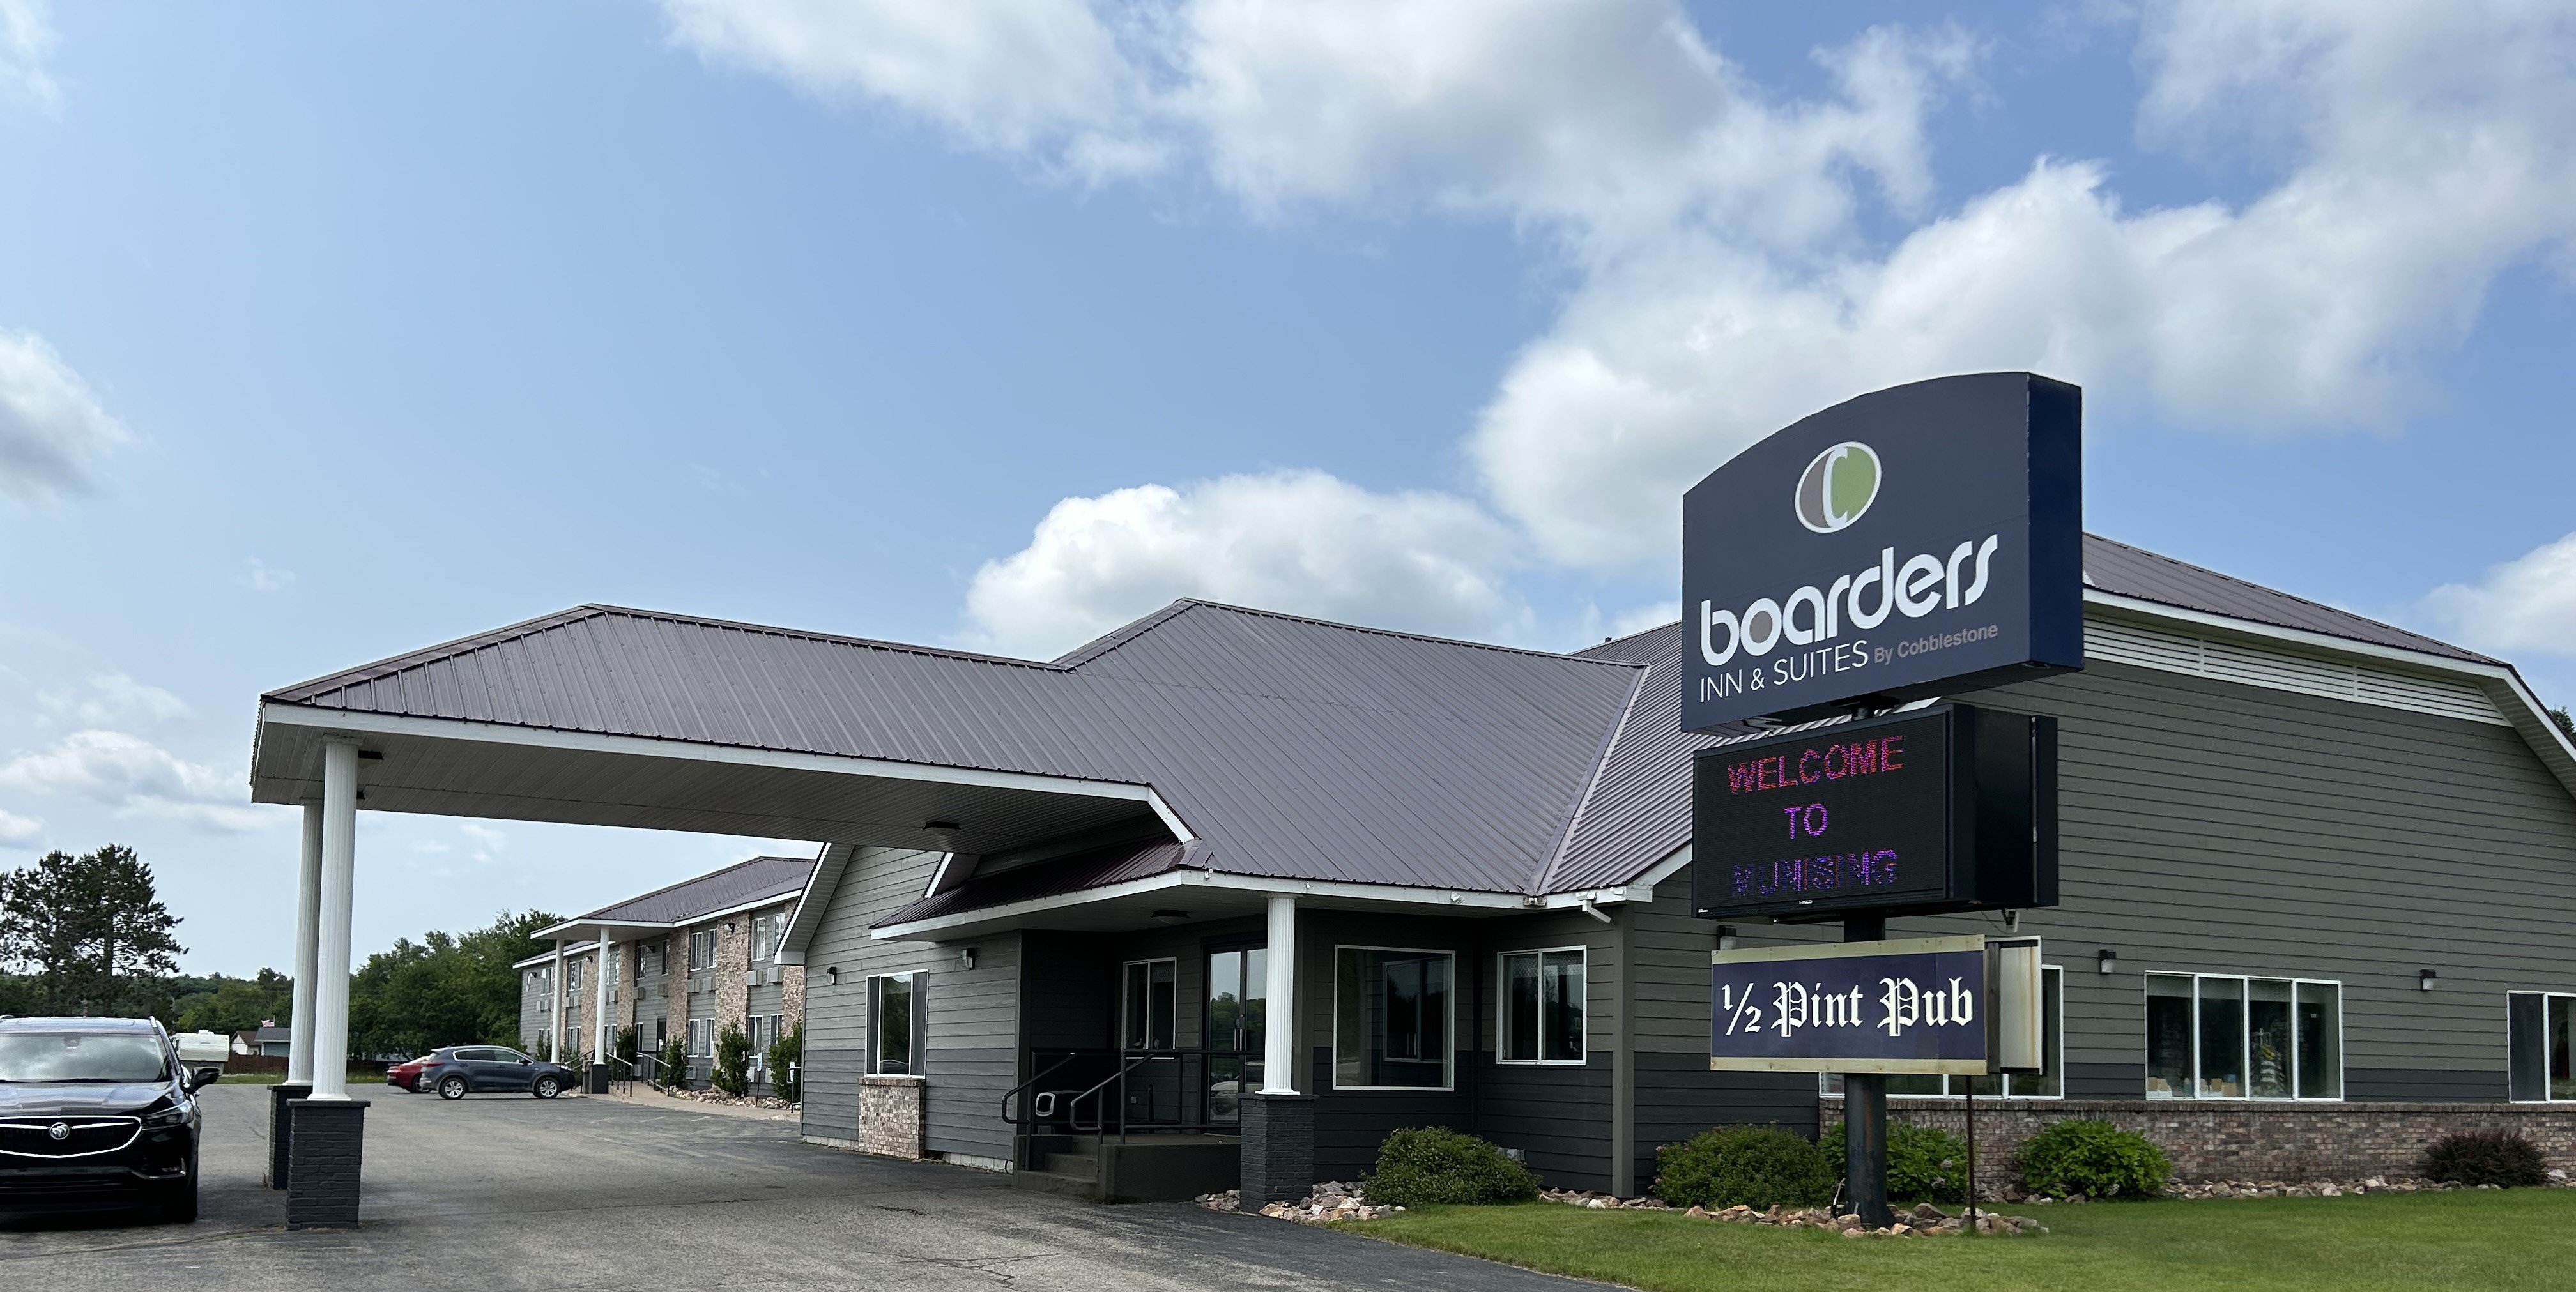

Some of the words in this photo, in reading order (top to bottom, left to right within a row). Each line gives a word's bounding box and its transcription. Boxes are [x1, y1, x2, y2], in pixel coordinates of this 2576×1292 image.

[1700, 533, 1998, 666] boarders
[1700, 669, 1743, 703] INN
[1750, 667, 1765, 691] &
[1773, 639, 1869, 685] SUITES
[1874, 646, 1894, 665] By
[1897, 624, 1998, 658] Cobblestone
[1727, 734, 1905, 794] WELCOME
[1783, 803, 1829, 839] TO
[1771, 981, 1864, 1037] Pint
[1876, 976, 1974, 1037] Pub
